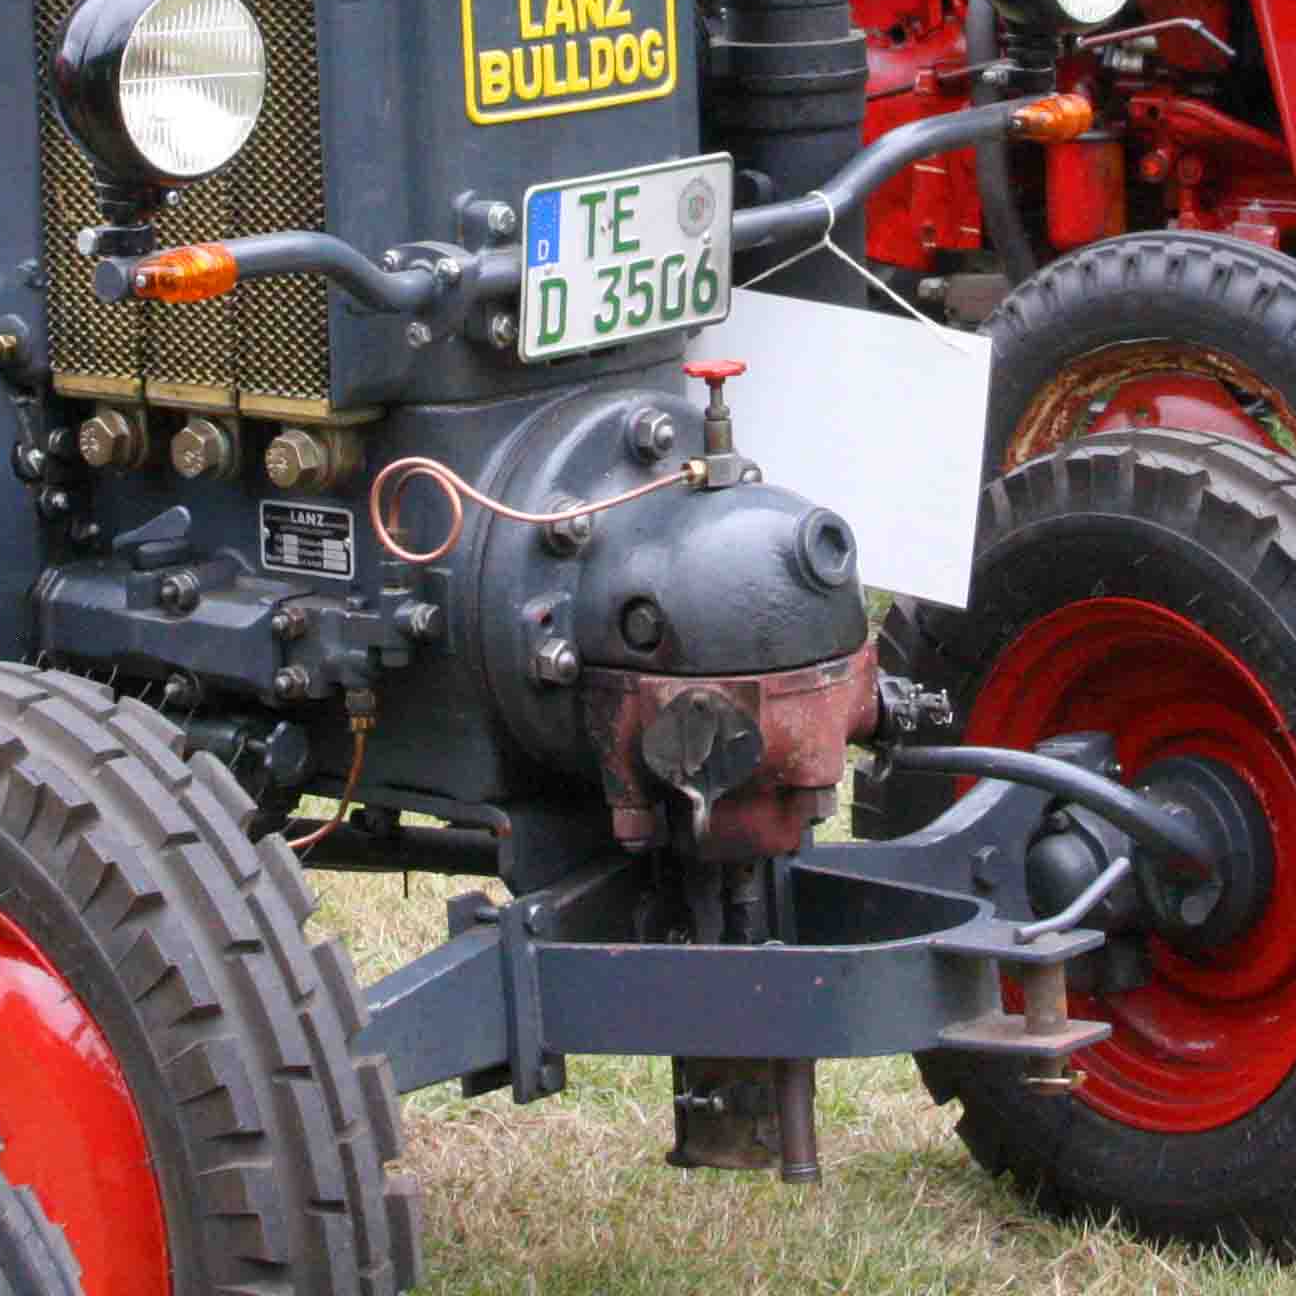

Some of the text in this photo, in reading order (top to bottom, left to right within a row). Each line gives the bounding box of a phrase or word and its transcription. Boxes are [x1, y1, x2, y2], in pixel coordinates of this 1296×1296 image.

[478, 28, 665, 106] BULLDOG
[537, 239, 549, 262] D
[579, 184, 640, 259] TE
[537, 243, 719, 346] D 3506
[291, 511, 325, 526] LANZ
